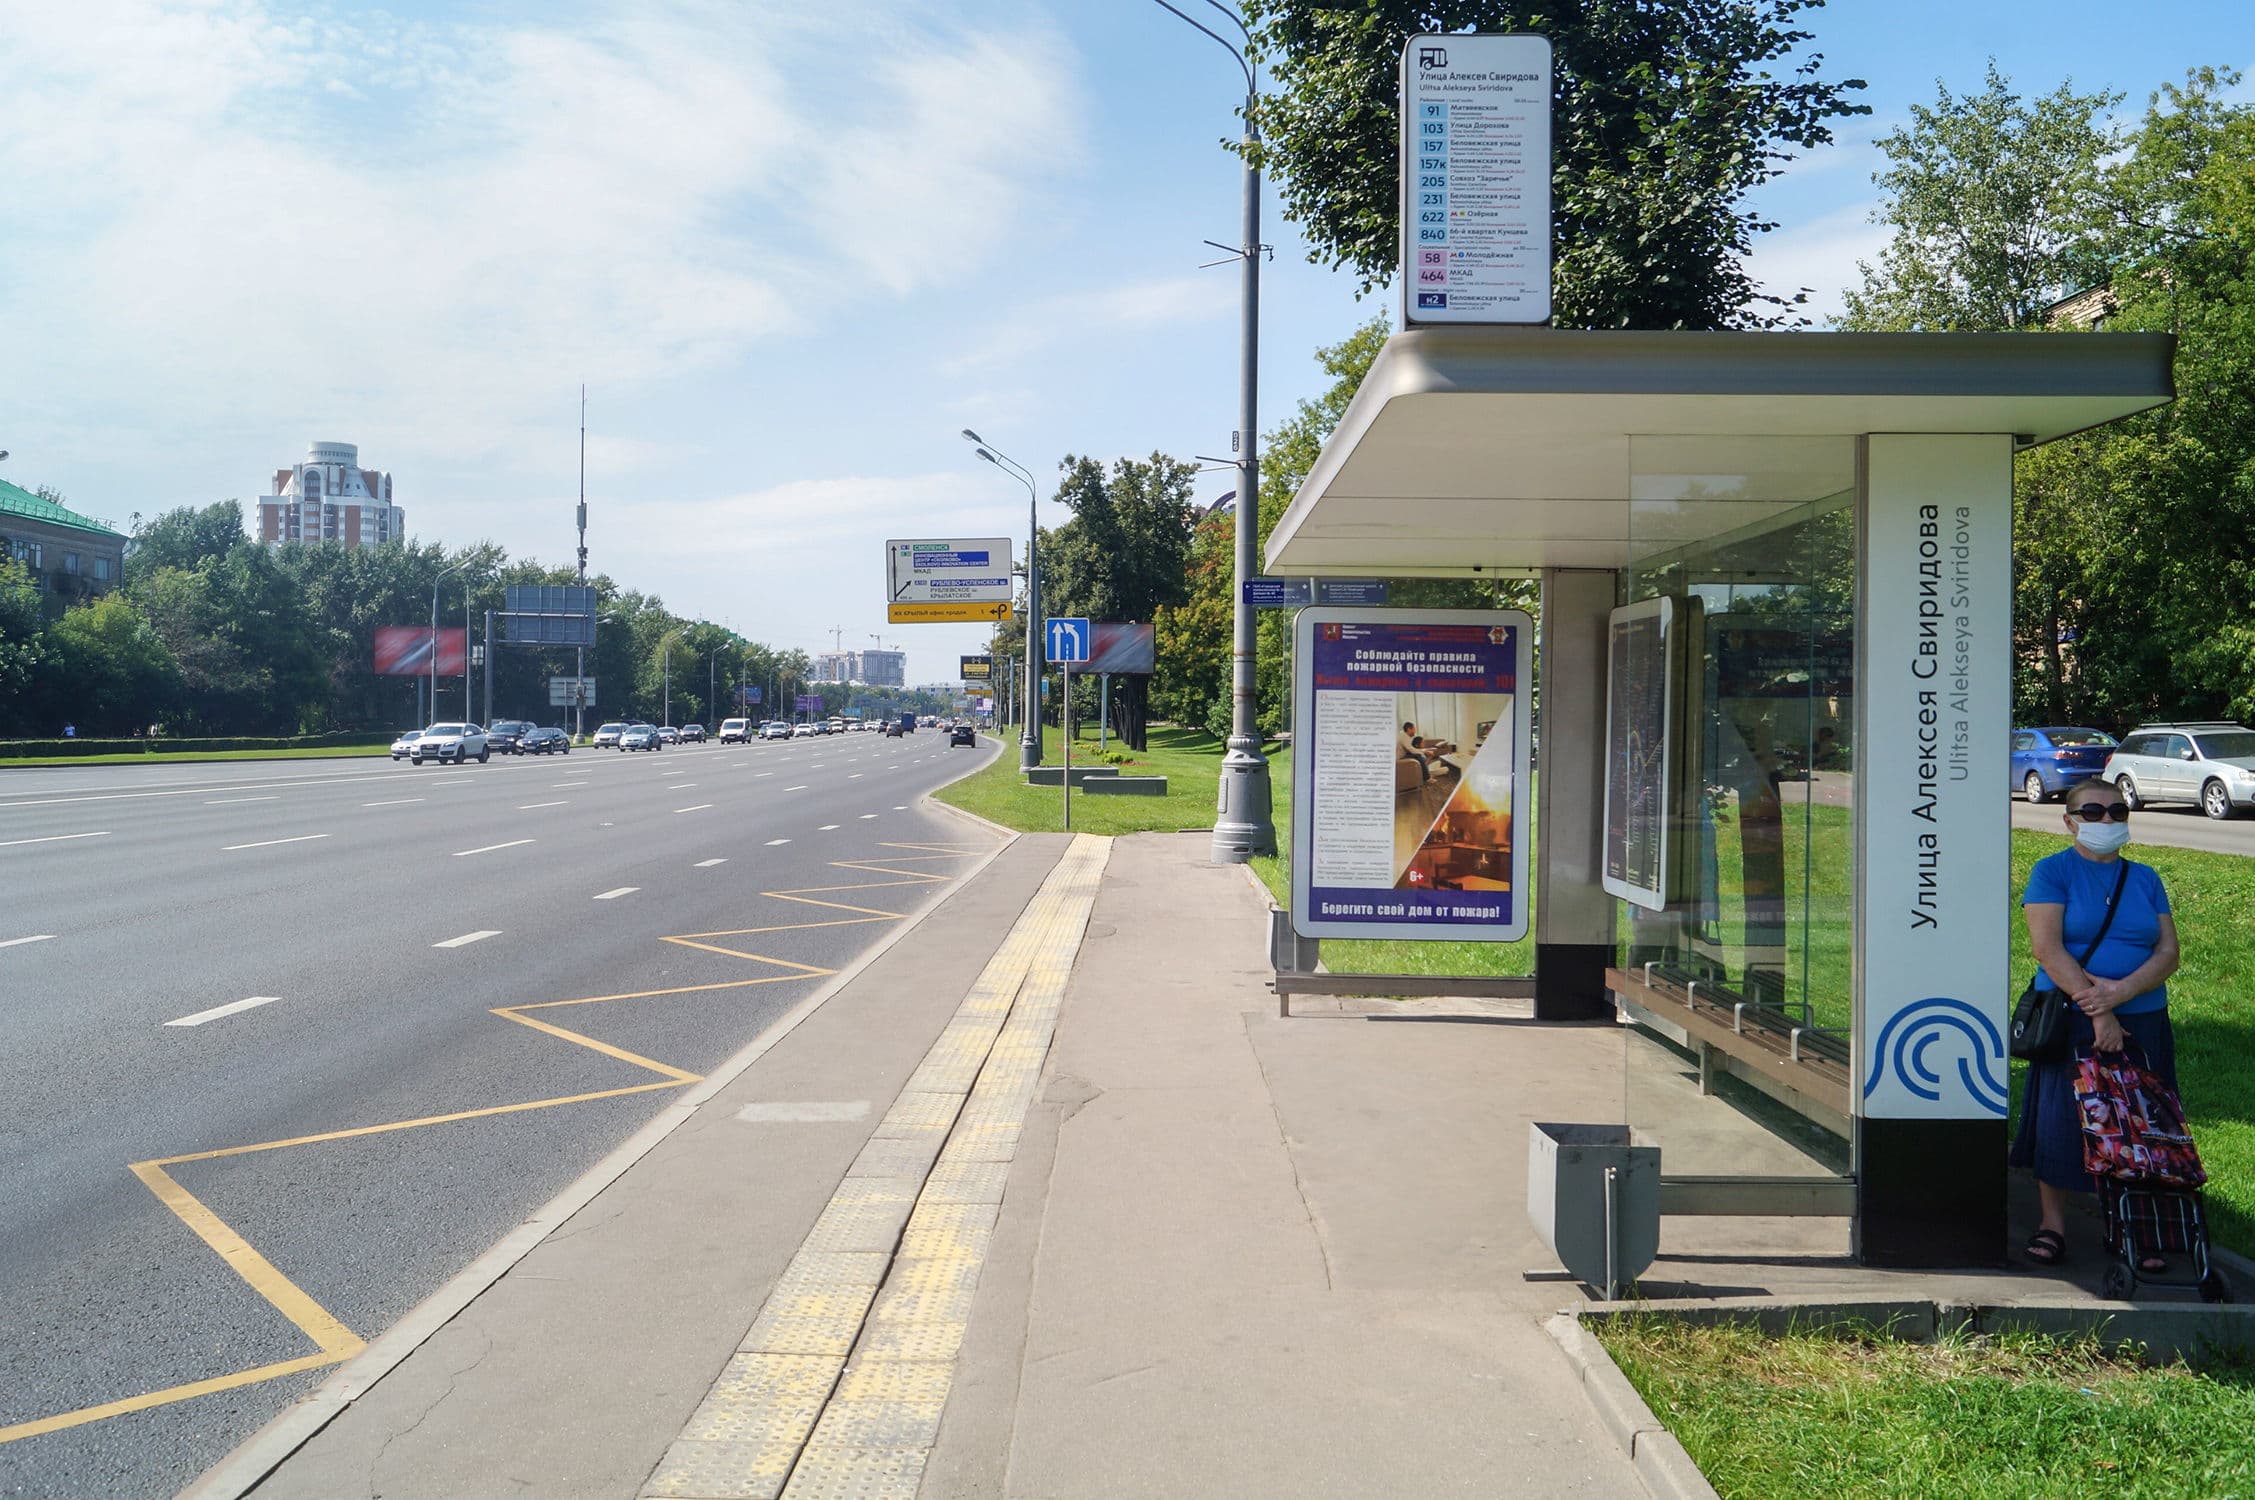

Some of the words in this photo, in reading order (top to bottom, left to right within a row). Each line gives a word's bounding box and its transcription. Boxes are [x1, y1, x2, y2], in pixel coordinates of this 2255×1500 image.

[1419, 72, 1447, 82] Улица
[1449, 72, 1487, 81] Алексея
[1488, 72, 1539, 82] Свиридова
[1442, 84, 1476, 92] Alekseya
[1478, 84, 1513, 92] Sviridova
[1427, 105, 1439, 116] 91
[1423, 123, 1444, 134] 103
[1424, 141, 1443, 152] 157
[1420, 159, 1447, 169] 157к
[1421, 176, 1445, 186] 205
[1423, 194, 1443, 204] 231
[1421, 212, 1445, 222] 622
[1420, 229, 1445, 240] 840
[1424, 253, 1441, 263] 58
[1465, 251, 1514, 259] Молодёжная
[1420, 271, 1444, 281] 464
[1450, 269, 1473, 277] МКАД
[1949, 505, 1970, 609] Sviridova
[1911, 504, 1944, 680] Свиридова
[1355, 649, 1425, 662] Соблюдайте
[1429, 652, 1477, 663] правила
[1346, 662, 1402, 673] пожарной
[1406, 663, 1485, 674] безопасности
[1949, 615, 1974, 714] Alekseya
[1911, 690, 1938, 823] Алексея
[1949, 720, 1969, 782] Ulitsa
[1409, 870, 1424, 882] 6+
[1911, 834, 1941, 930] Улица
[1321, 902, 1373, 915] Берегите
[1377, 903, 1404, 916] свой
[1408, 906, 1432, 917] дом
[1436, 906, 1448, 916] от
[1452, 904, 1500, 918] пожара!
